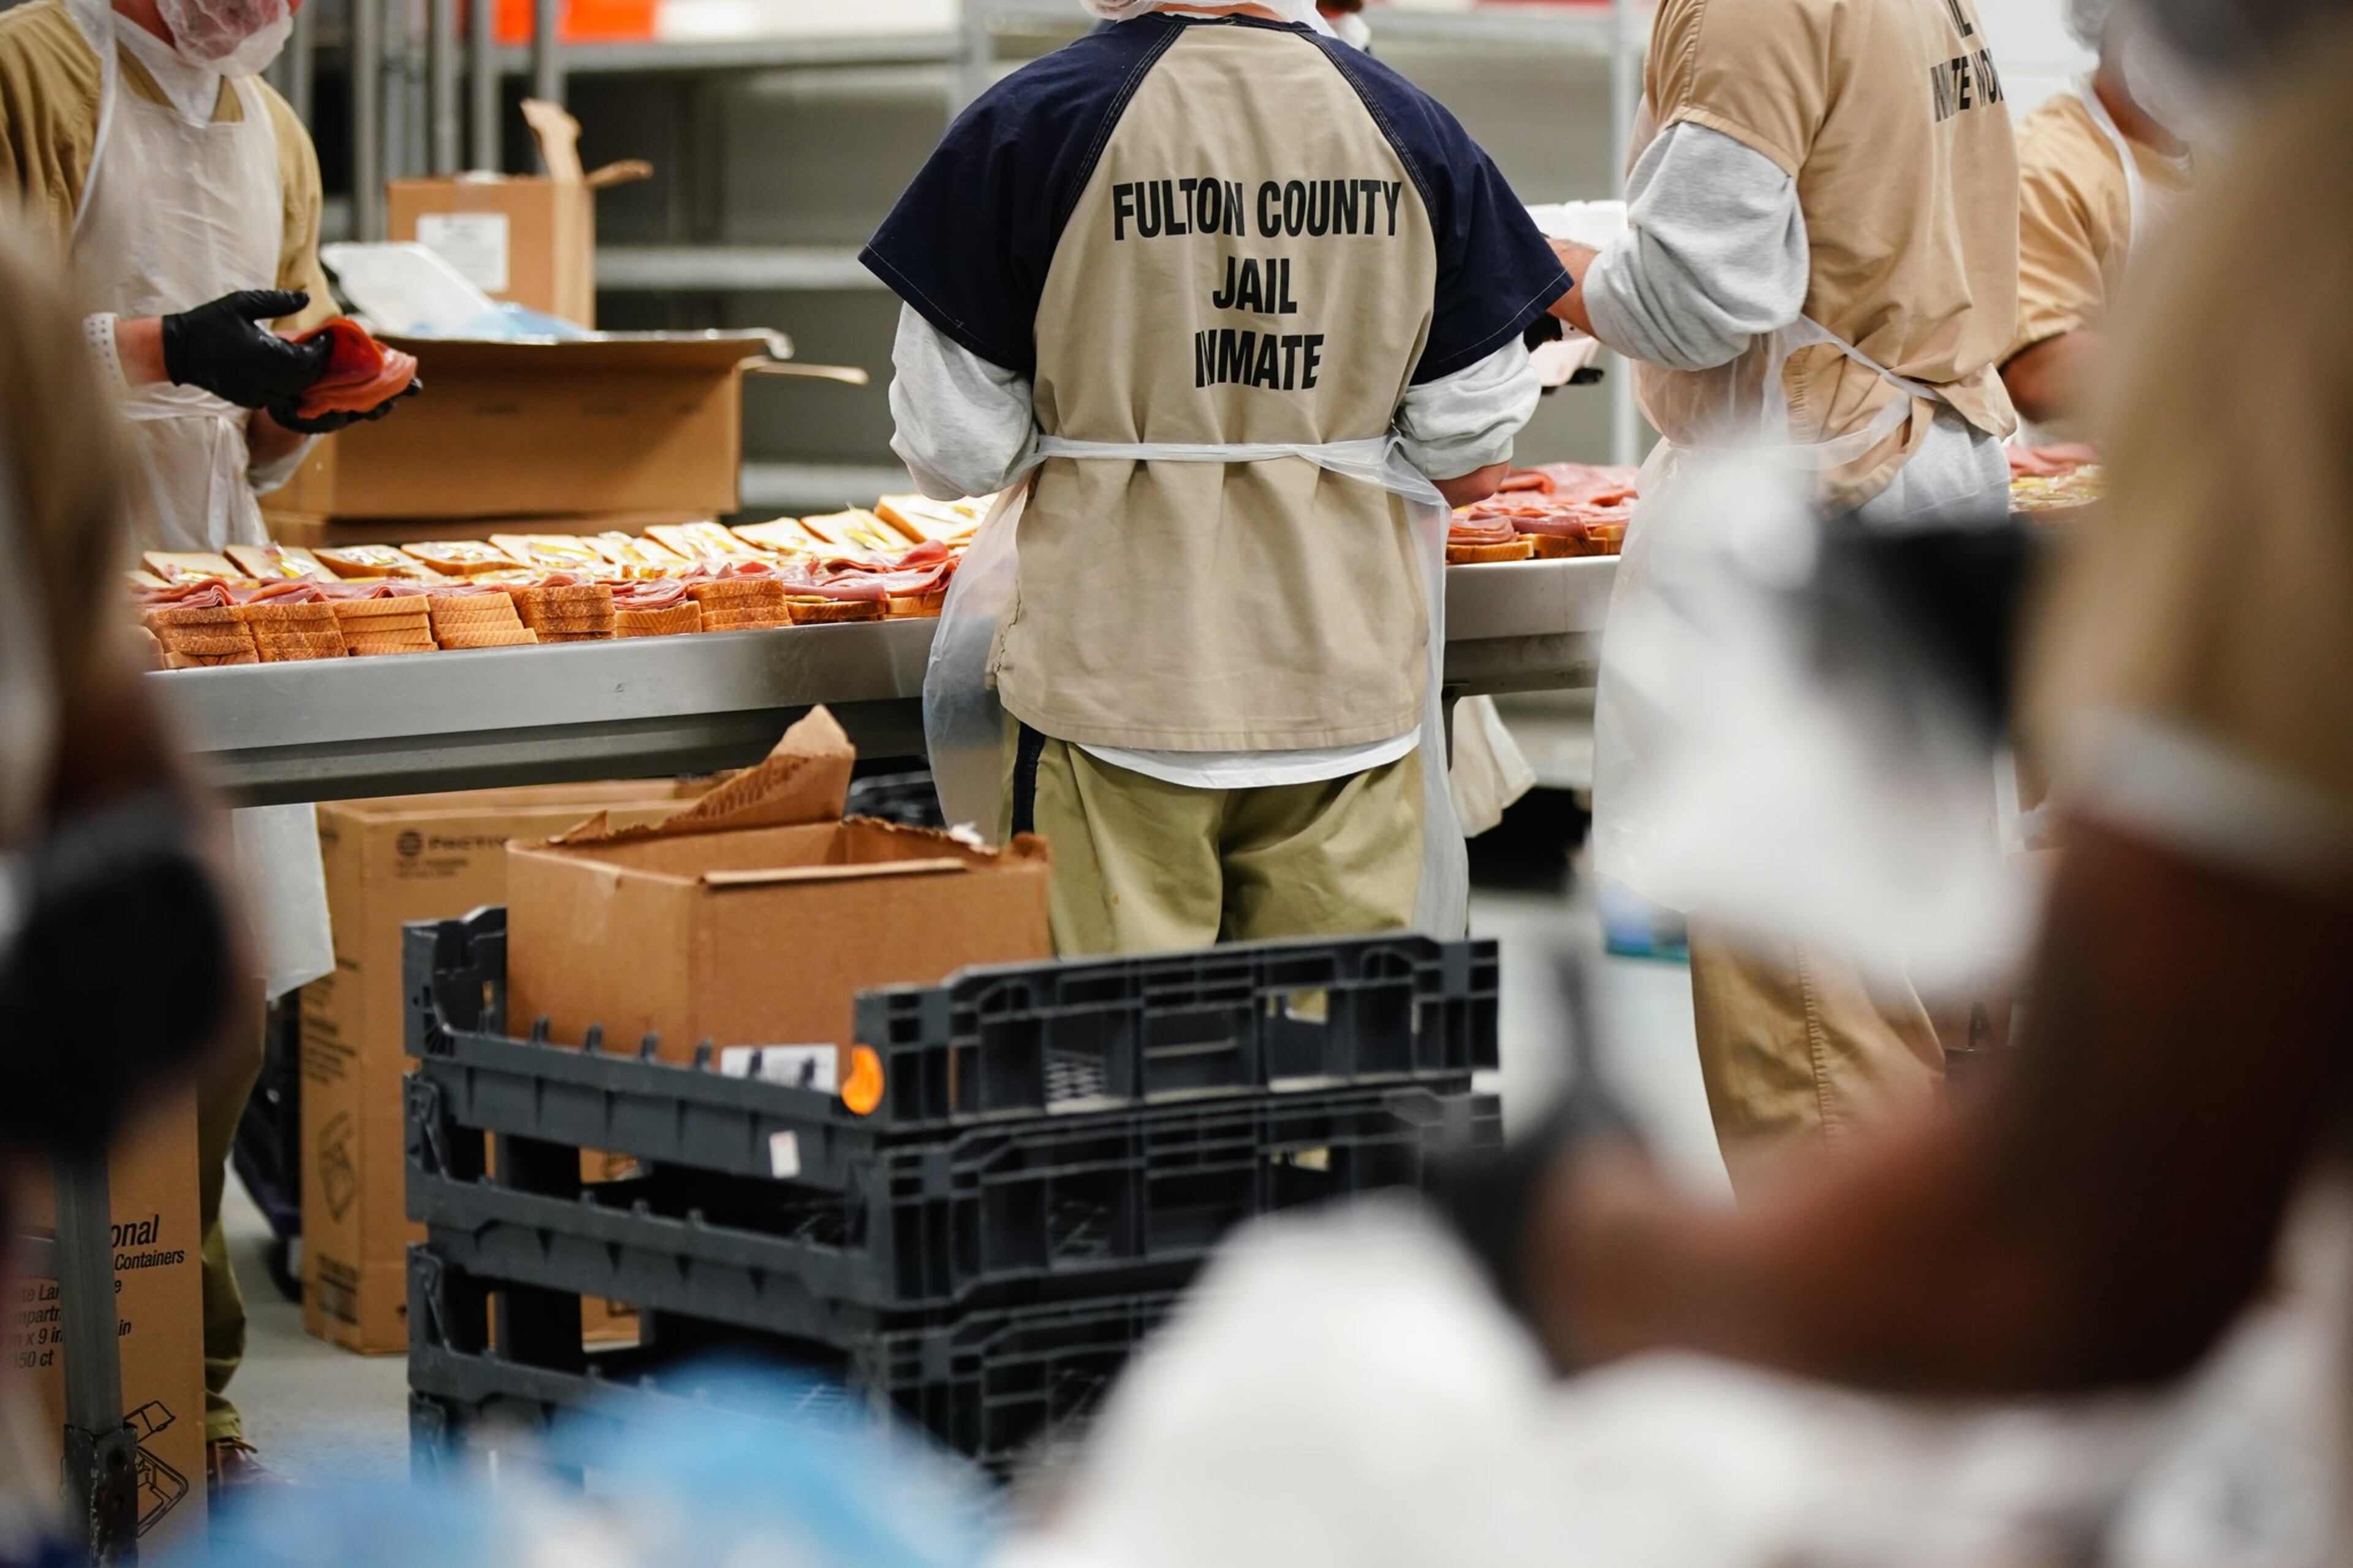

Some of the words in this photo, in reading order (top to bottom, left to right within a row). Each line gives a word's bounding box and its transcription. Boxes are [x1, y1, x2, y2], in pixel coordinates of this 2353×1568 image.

[1113, 177, 1245, 240] FULTON
[1257, 179, 1402, 238] COUNTY
[1213, 256, 1297, 314] JAIL
[115, 1250, 184, 1270] Containers
[37, 1327, 48, 1344] 9
[118, 1319, 131, 1336] in
[39, 1349, 54, 1366] ct
